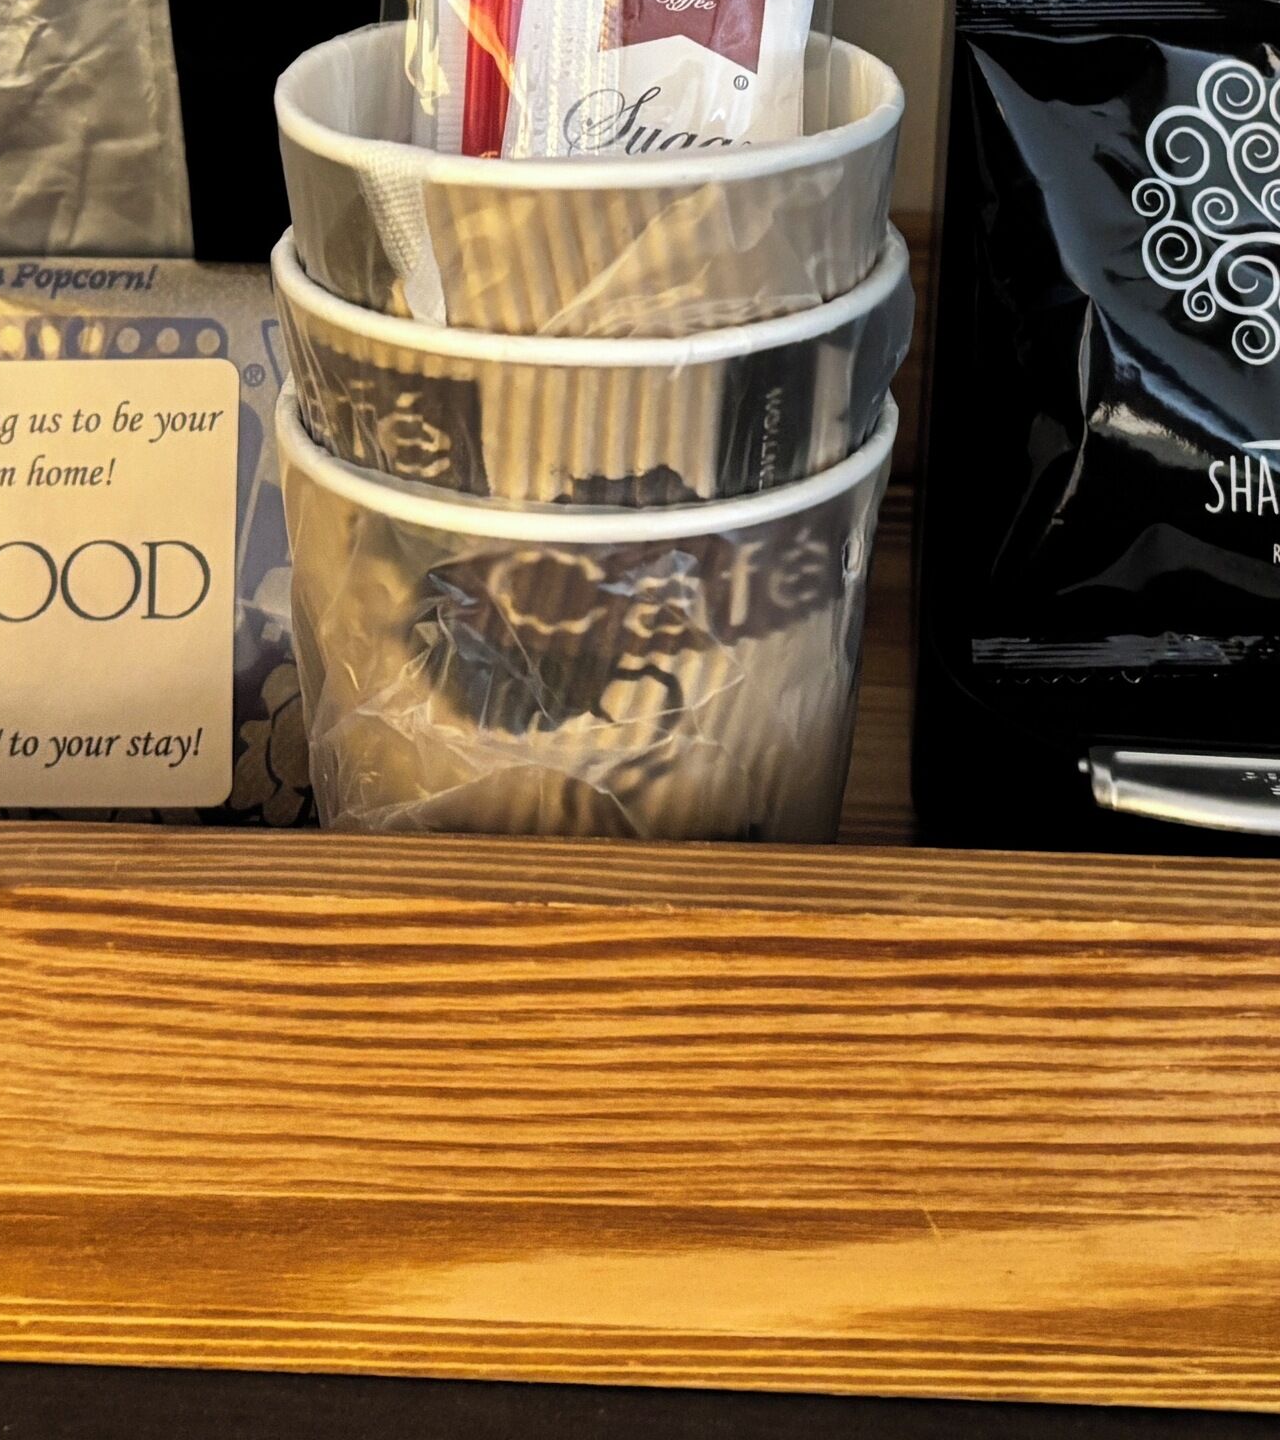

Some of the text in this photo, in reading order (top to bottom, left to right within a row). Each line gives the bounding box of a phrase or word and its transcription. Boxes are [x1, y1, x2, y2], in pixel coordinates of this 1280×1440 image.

[10, 264, 157, 299] Popcorn!
[29, 412, 63, 434] us
[71, 408, 102, 434] to
[112, 399, 144, 434] be
[148, 408, 225, 444] your
[26, 454, 116, 487] home!
[8, 728, 40, 758] to
[36, 734, 120, 768] your
[125, 727, 204, 768] stay!
